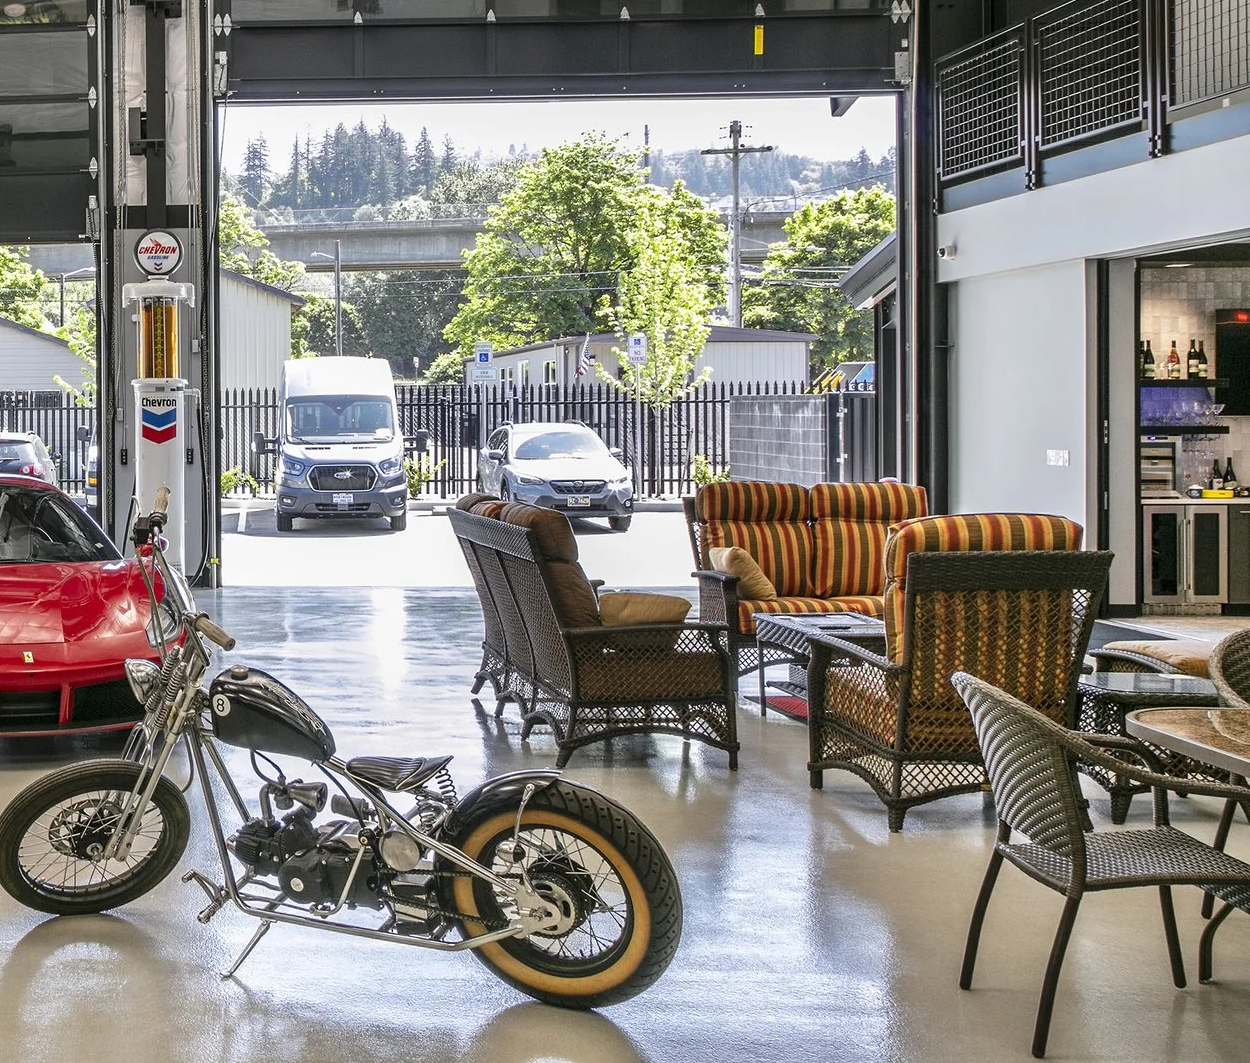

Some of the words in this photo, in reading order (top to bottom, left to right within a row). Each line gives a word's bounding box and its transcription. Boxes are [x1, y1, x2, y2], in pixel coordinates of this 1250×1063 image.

[139, 244, 177, 255] CHEVRON
[141, 397, 177, 407] Chevron
[216, 698, 225, 712] 8
